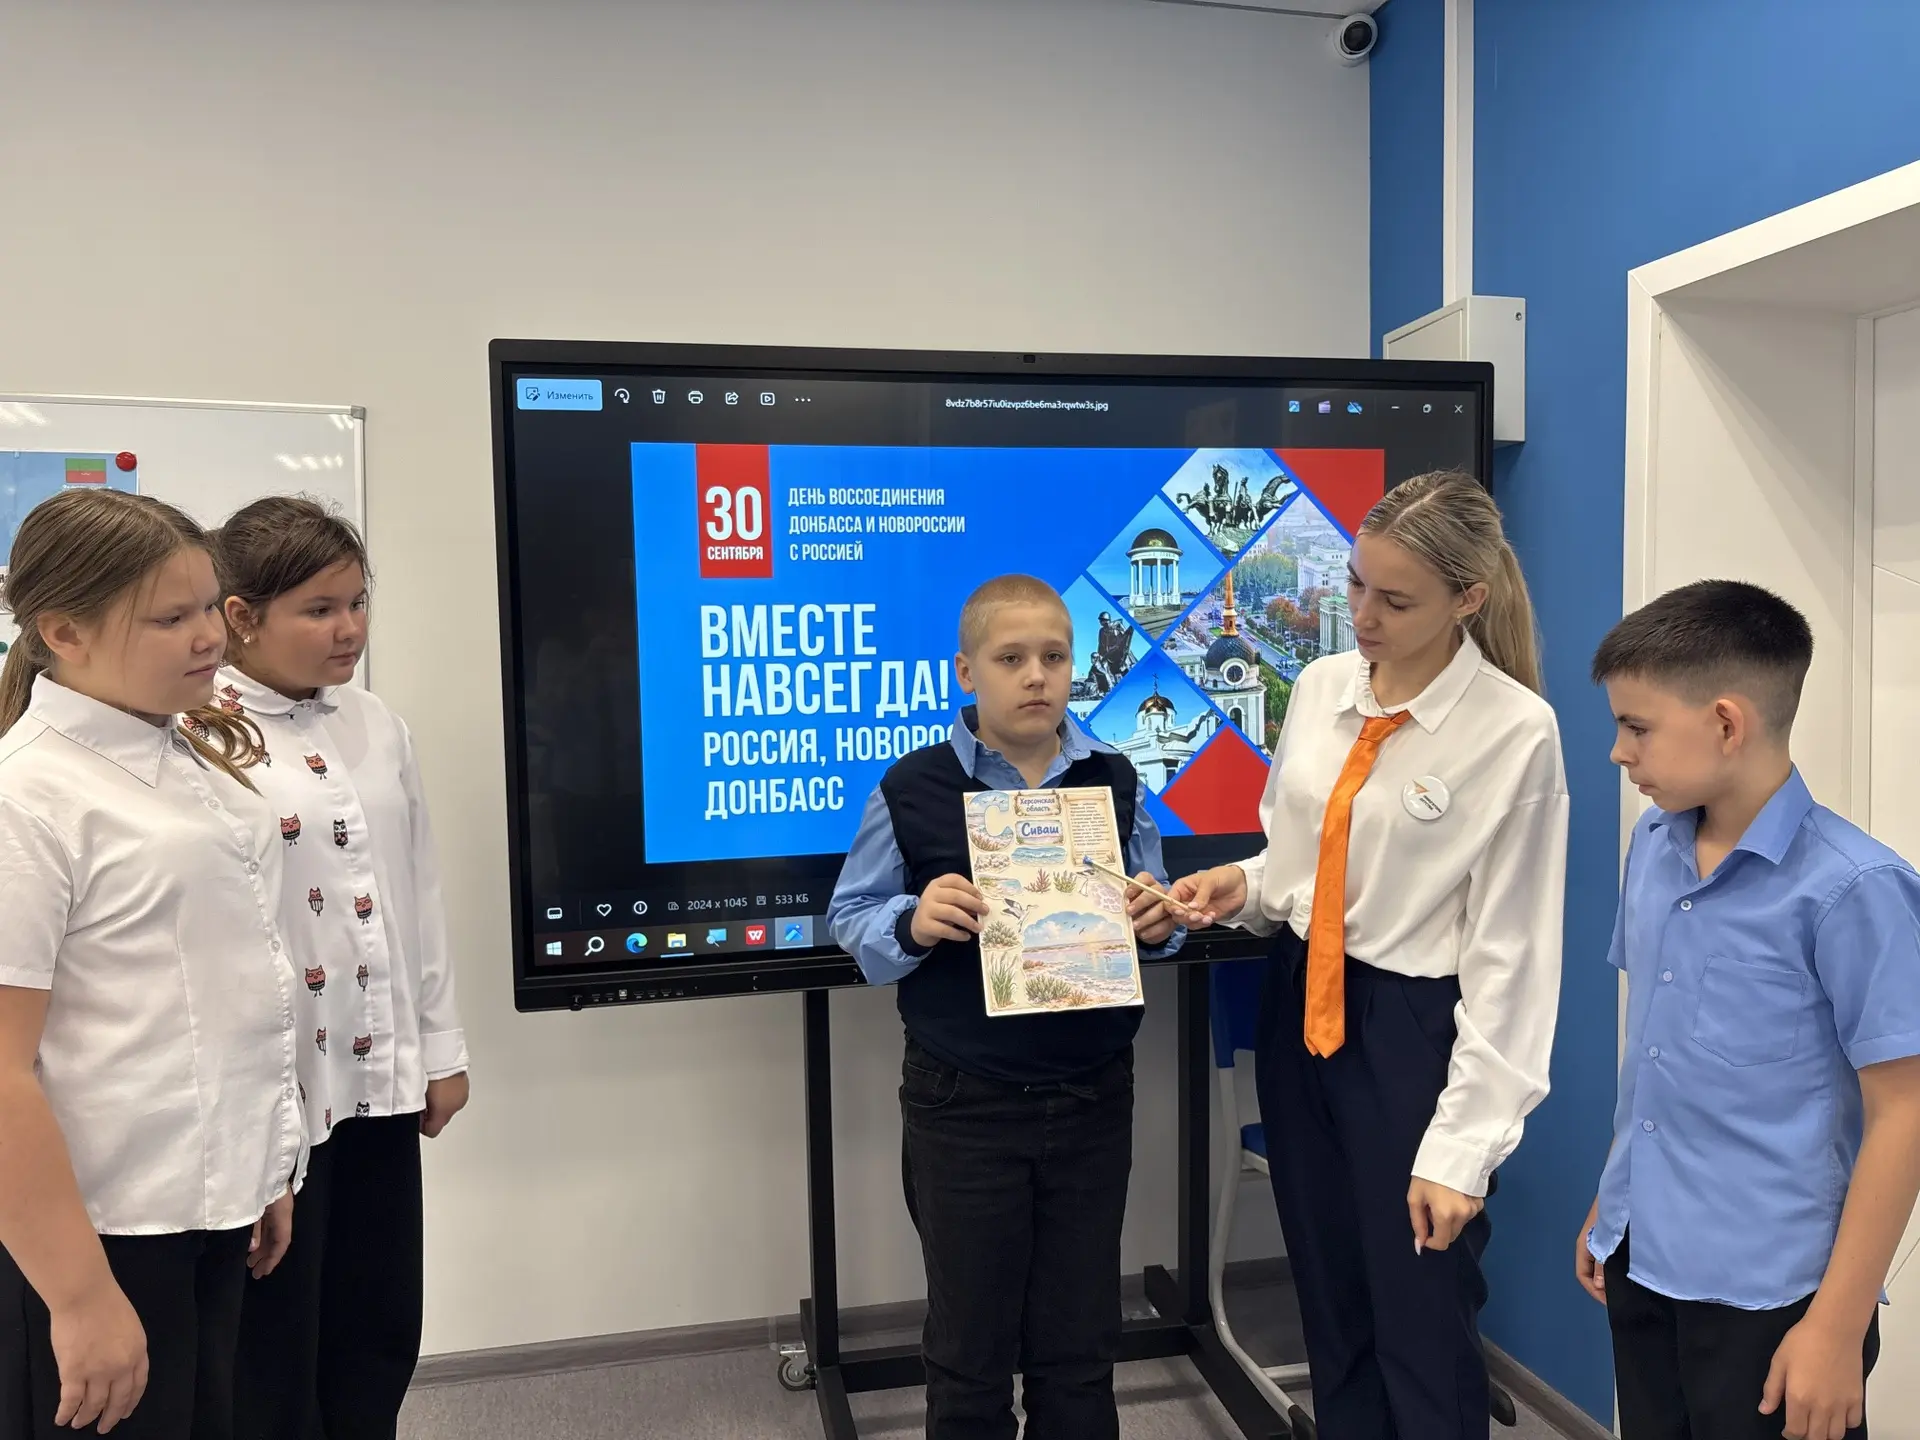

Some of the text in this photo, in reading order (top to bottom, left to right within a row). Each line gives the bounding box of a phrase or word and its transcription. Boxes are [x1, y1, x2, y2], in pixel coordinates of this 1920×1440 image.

[547, 390, 594, 401] Изменить
[788, 488, 945, 508] ДЕНЬ ВОССОЕДИНЕНИЯ
[704, 486, 763, 541] 30
[788, 516, 966, 535] ДОНБАССА И НОВОРОССИИ
[707, 546, 764, 561] СЕНТЯБРЯ
[789, 541, 864, 561] С РОССИЕЙ
[700, 603, 877, 658] ВМЕСТЕ
[702, 659, 950, 719] НАВСЕГДА!
[704, 724, 954, 768] РОССИЯ, НОВОРО
[704, 776, 845, 821] ДОНБАСС
[1020, 797, 1055, 806] Херсонская
[1021, 822, 1059, 837] Сиваш
[687, 900, 712, 910] 2024
[724, 897, 748, 908] 1045
[775, 893, 809, 904] 533 КБ
